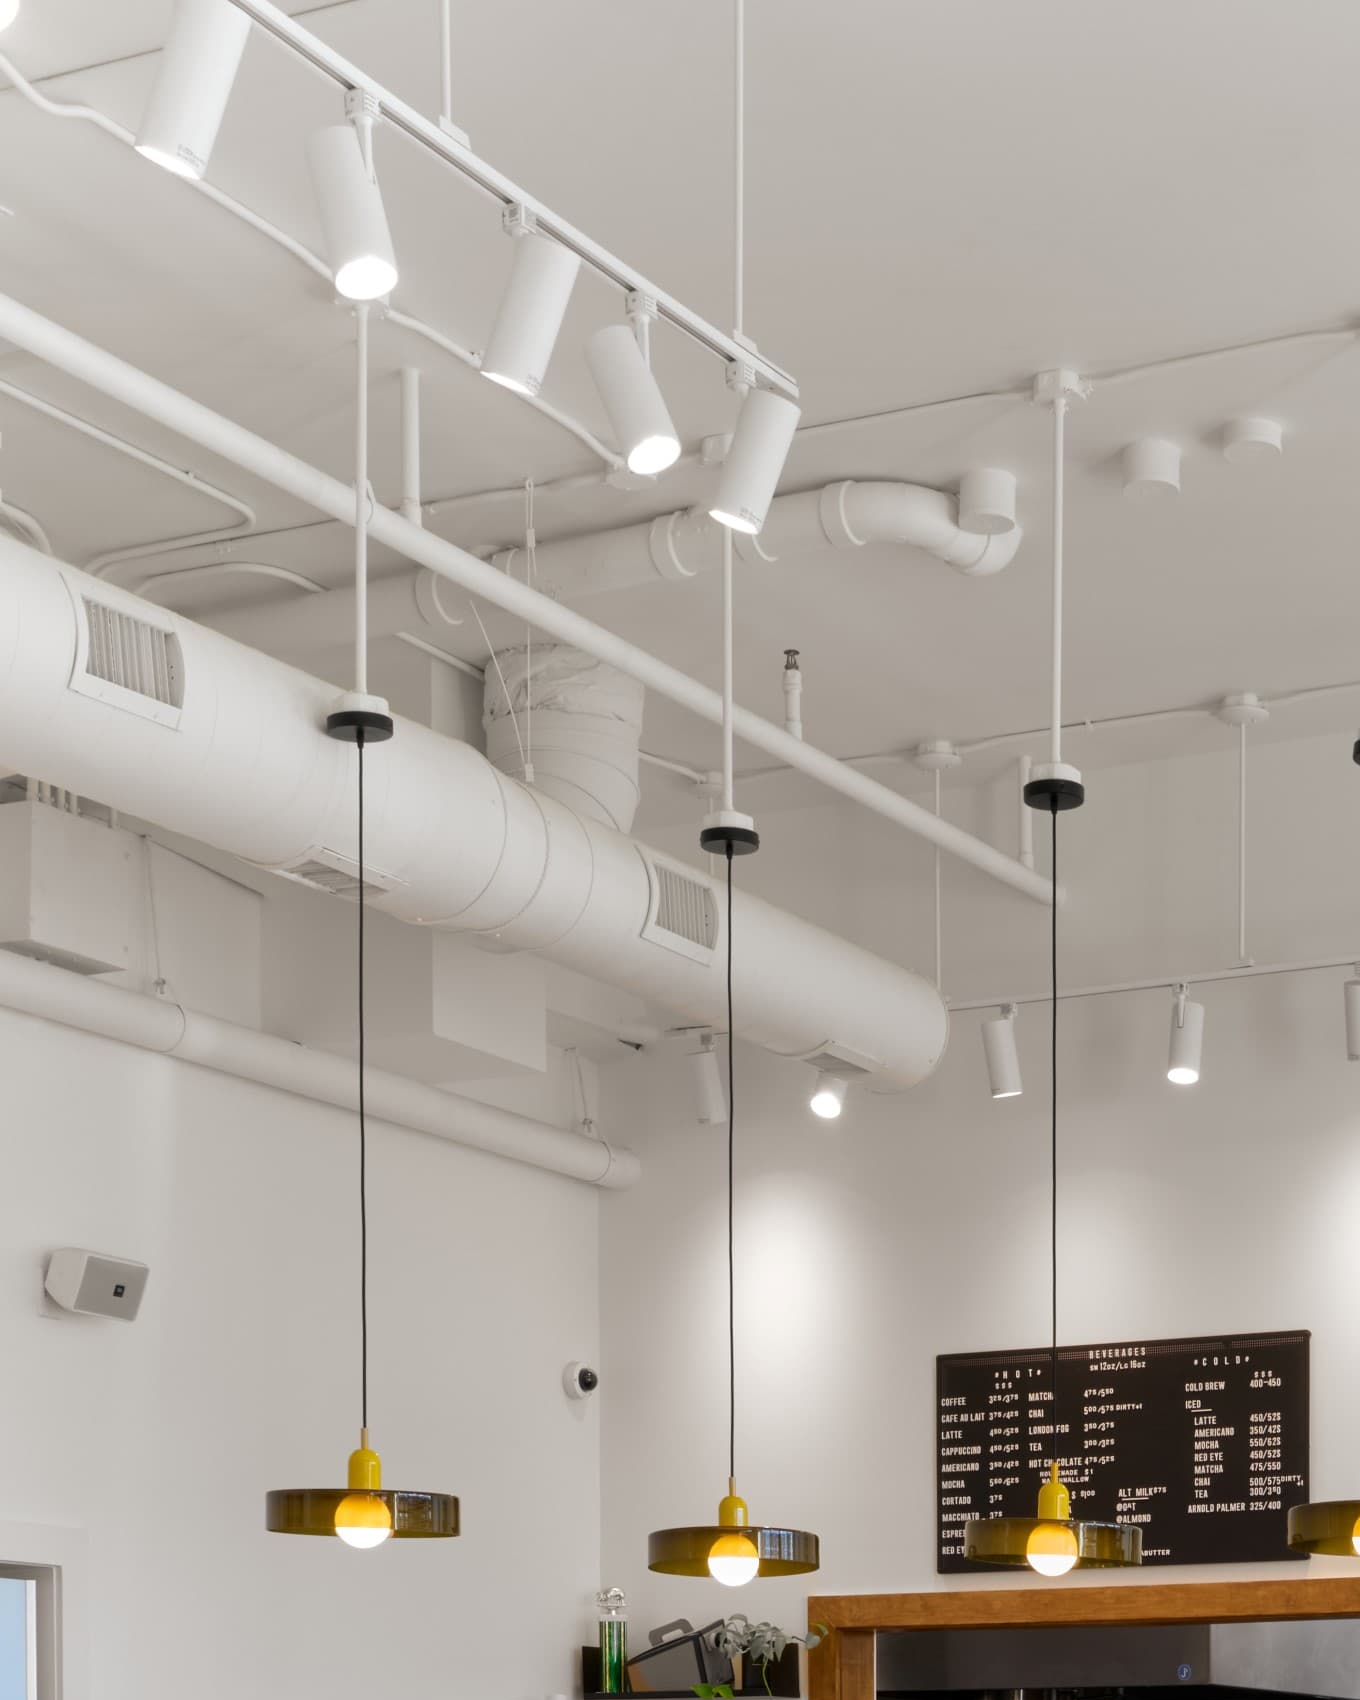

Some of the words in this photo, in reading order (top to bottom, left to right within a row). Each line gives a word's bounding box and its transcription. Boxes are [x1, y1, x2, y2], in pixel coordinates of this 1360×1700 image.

[1089, 1347, 1146, 1360] BEVERAGES
[1185, 1382, 1203, 1392] COLD
[1205, 1381, 1225, 1391] BREW
[941, 1397, 966, 1406] COFFEE
[1028, 1392, 1054, 1401] MATCH
[1185, 1400, 1201, 1409] ICED
[941, 1414, 958, 1423] CAFE
[960, 1413, 969, 1422] AU
[970, 1412, 985, 1421] LAIT
[1028, 1409, 1044, 1418] CHAI
[1194, 1416, 1216, 1425] LATTE
[1028, 1425, 1054, 1435] LONDON
[1056, 1424, 1070, 1433] FOG
[1194, 1427, 1235, 1438] AMERICANO
[941, 1430, 963, 1440] LATTE
[1029, 1443, 1042, 1451] TEA
[1194, 1440, 1219, 1450] MOCHA
[941, 1446, 981, 1456] CAPPUCCINO
[1194, 1453, 1208, 1462] RED
[1209, 1452, 1224, 1461] EYE
[941, 1463, 979, 1472] AMERICANO
[1028, 1459, 1041, 1468] HOT
[1043, 1457, 1082, 1467] CHCOLATE
[1194, 1465, 1224, 1474] MATCHA
[941, 1480, 965, 1489] MOCHA
[1194, 1477, 1211, 1486] CHAI
[1118, 1488, 1132, 1497] ALT
[1136, 1487, 1153, 1496] MILK
[1194, 1490, 1208, 1498] TEA
[941, 1496, 972, 1506] CORTADO
[1188, 1504, 1215, 1514] ARNOLD
[1216, 1502, 1245, 1512] PALMER
[941, 1512, 979, 1522] MACCHIATO
[941, 1529, 966, 1539] ESPRES
[941, 1546, 955, 1555] RED
[956, 1545, 965, 1555] EY
